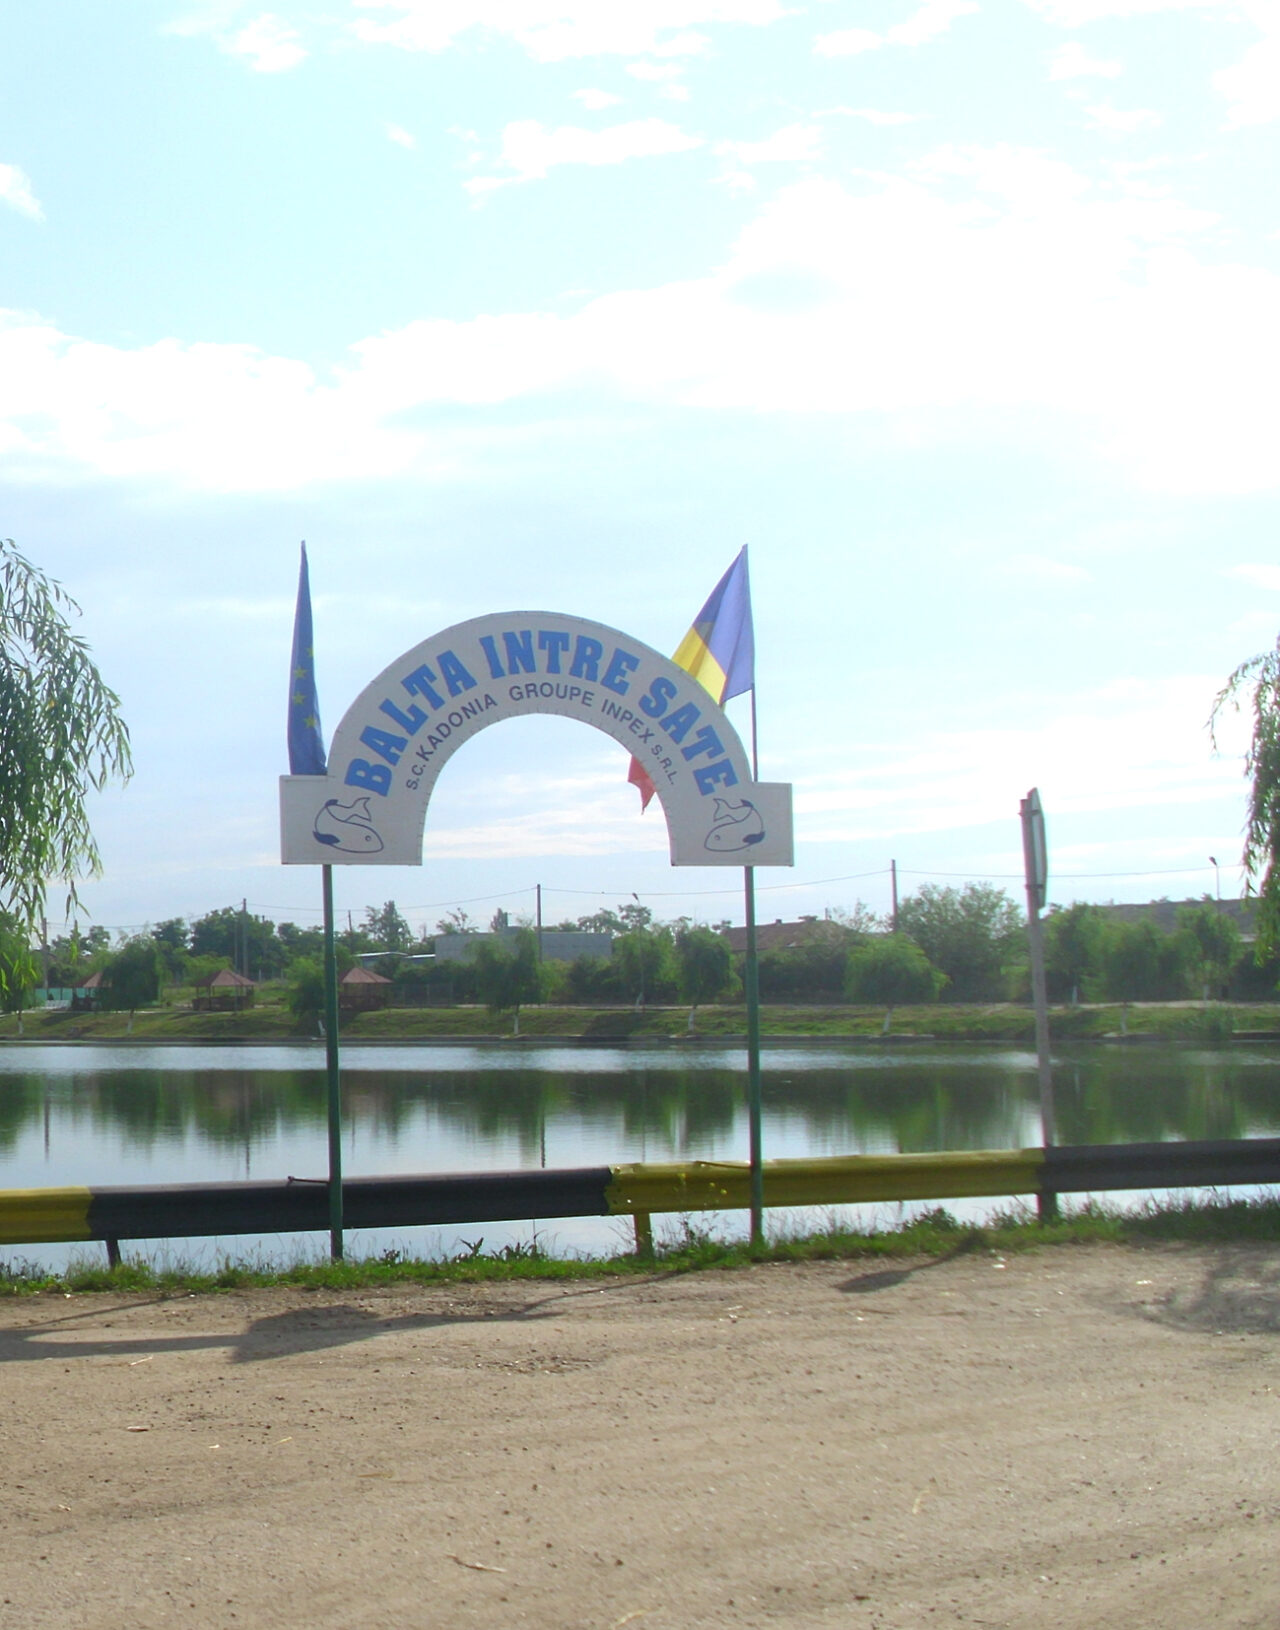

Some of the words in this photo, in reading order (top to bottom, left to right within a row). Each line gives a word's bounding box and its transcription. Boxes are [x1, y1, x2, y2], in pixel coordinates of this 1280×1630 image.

[344, 650, 478, 797] BALTA
[479, 630, 640, 697] INTRE
[639, 677, 738, 796] SATE
[509, 682, 595, 707] GROUPE
[601, 699, 654, 745] INPEX
[650, 744, 677, 785] S.R.L.
